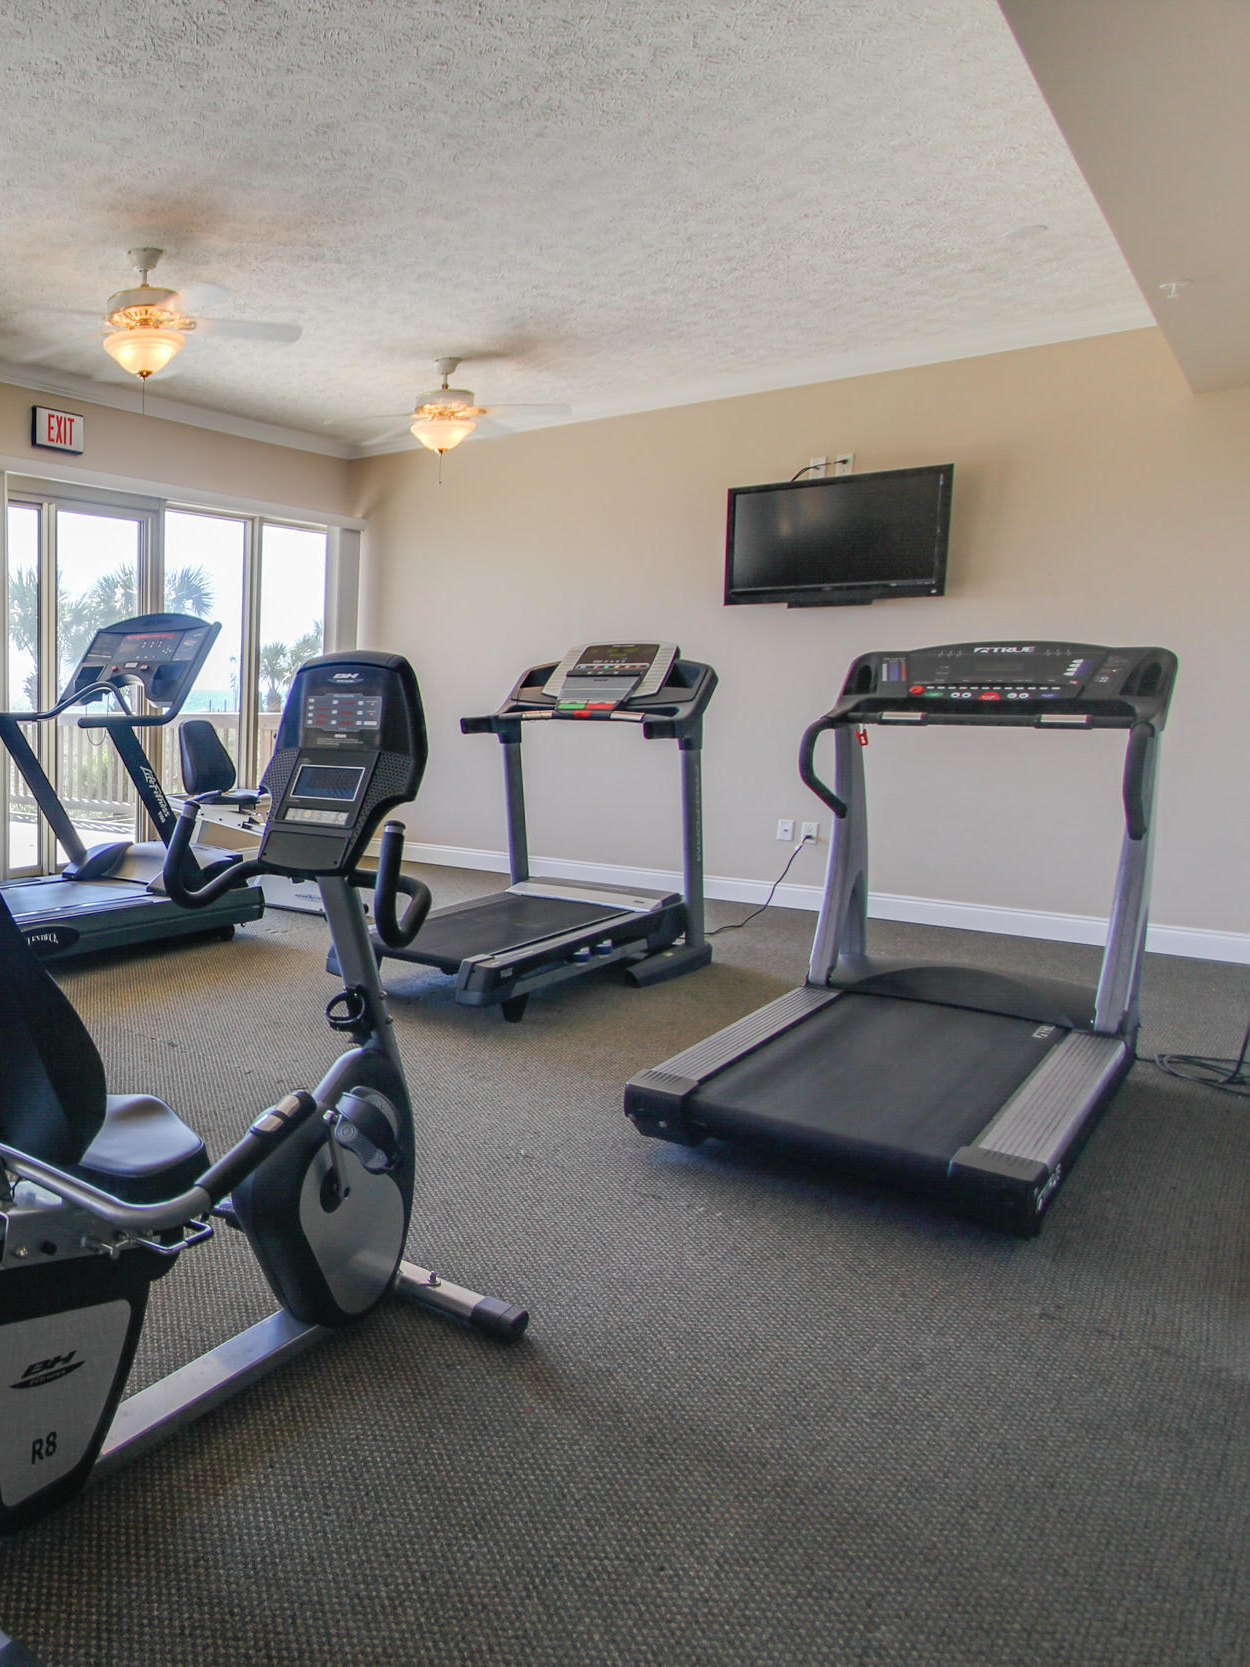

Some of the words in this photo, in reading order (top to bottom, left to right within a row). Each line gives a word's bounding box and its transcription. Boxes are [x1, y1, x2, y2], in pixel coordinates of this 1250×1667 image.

[47, 413, 75, 446] EXIT
[21, 1350, 78, 1379] BH
[31, 1431, 57, 1465] R8
